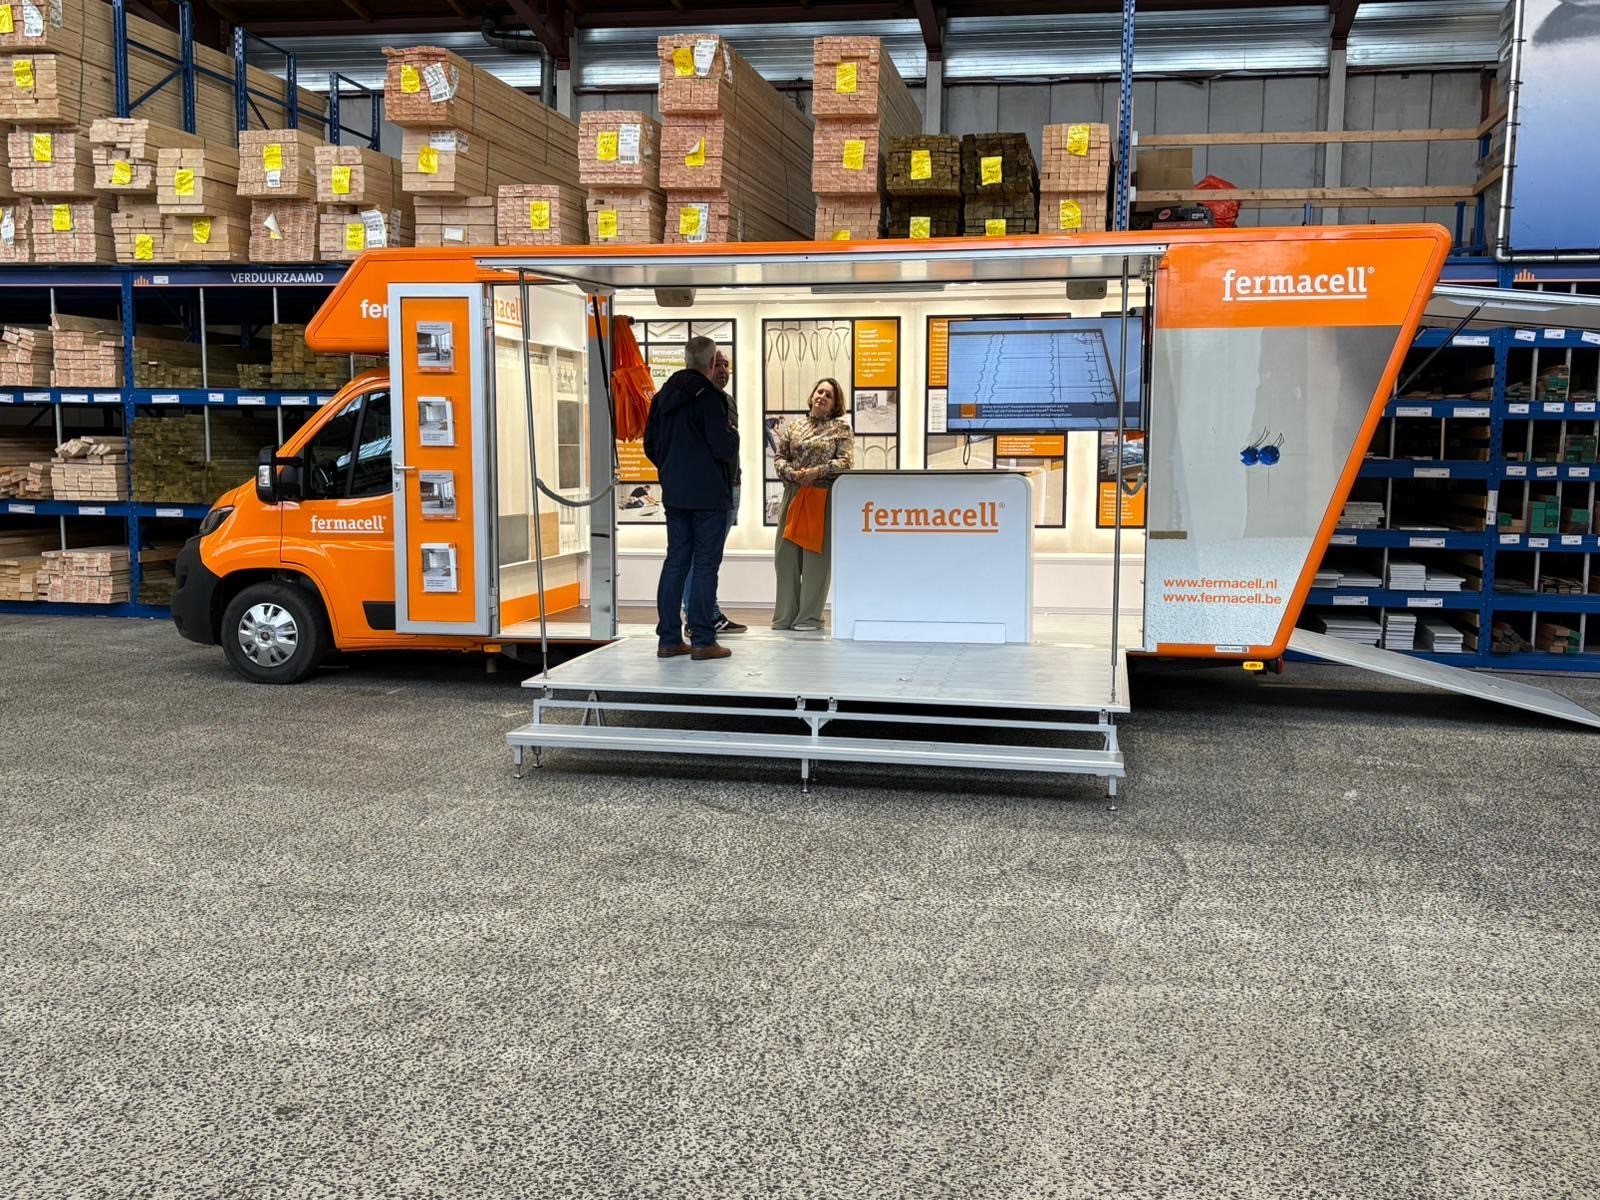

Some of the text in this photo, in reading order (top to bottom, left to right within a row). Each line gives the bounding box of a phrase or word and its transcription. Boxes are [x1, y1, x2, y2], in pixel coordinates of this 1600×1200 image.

[230, 272, 324, 283] VERDUURZAAMD
[1163, 577, 1278, 590] www.fermacell.nl
[1162, 592, 1282, 604] www.fermacell.be
